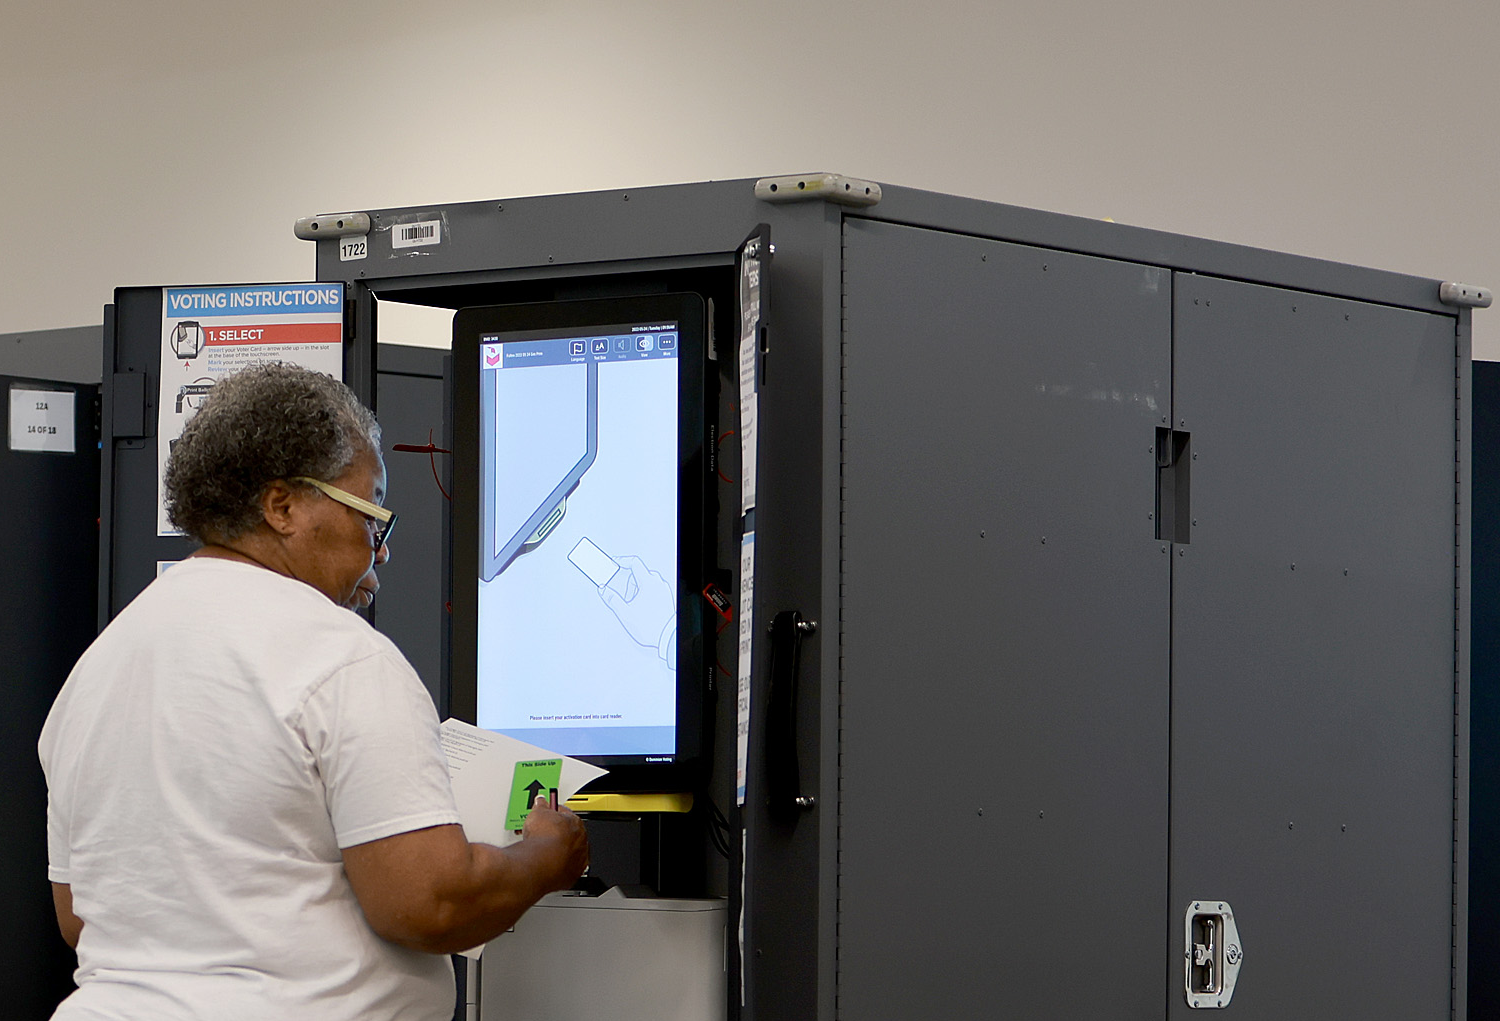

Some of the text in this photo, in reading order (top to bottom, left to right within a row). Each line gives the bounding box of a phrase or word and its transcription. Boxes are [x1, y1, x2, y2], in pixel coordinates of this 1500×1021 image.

[341, 242, 366, 258] 1722
[170, 289, 340, 310] VOTING INSTRUCTIONS
[208, 329, 264, 341] 1. SELECT
[35, 402, 49, 411] 12A
[27, 425, 57, 435] 14 OF 18
